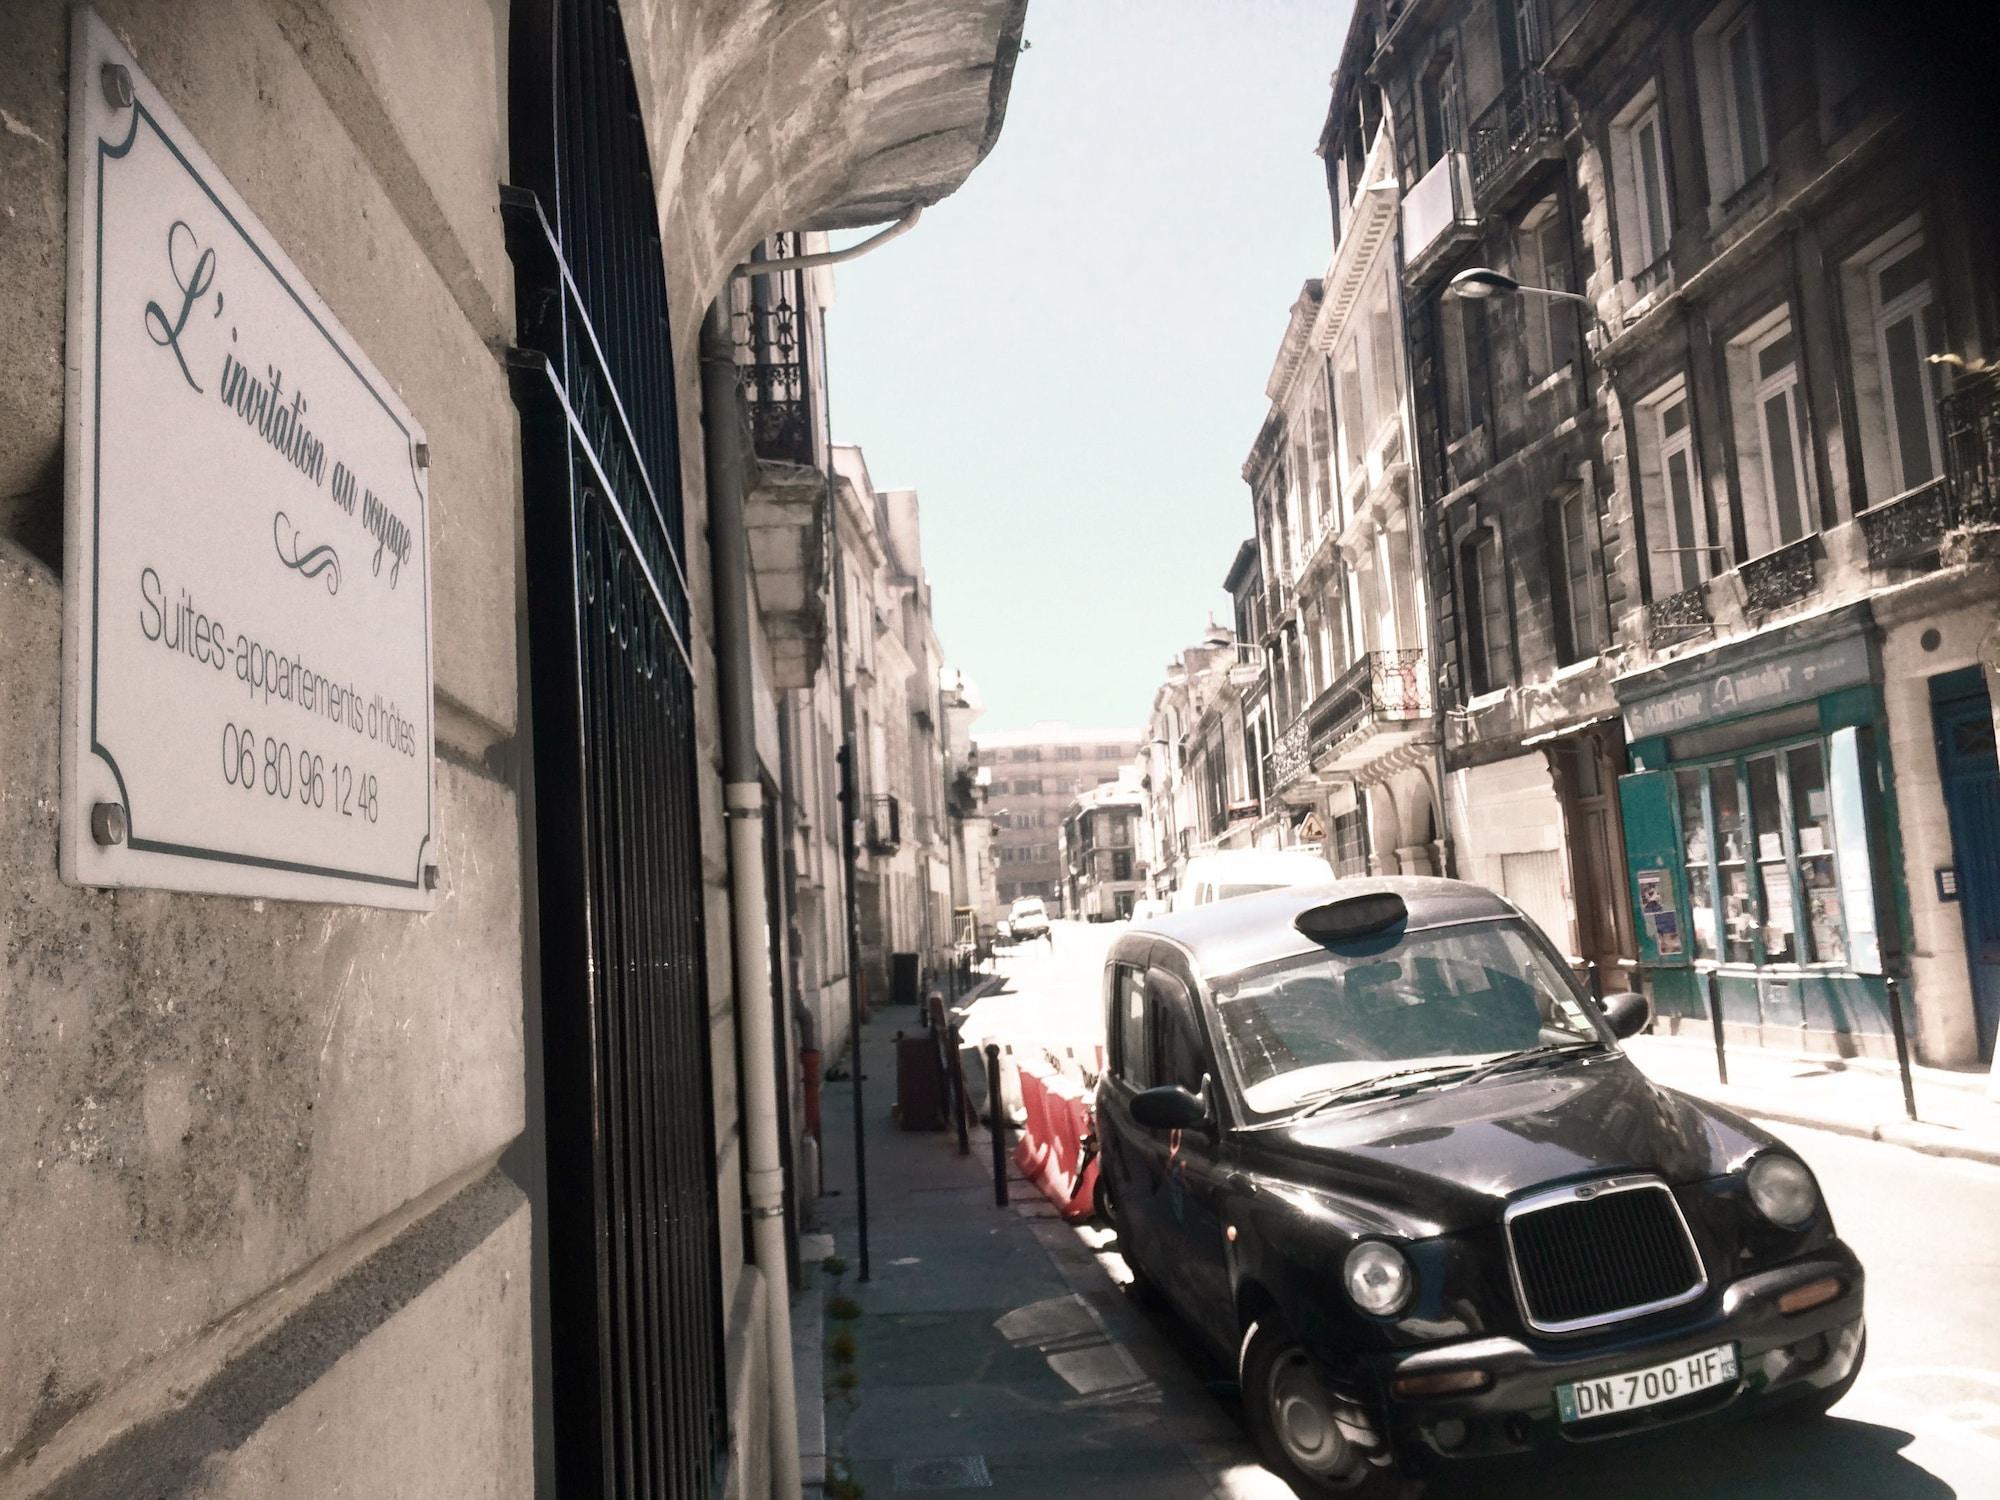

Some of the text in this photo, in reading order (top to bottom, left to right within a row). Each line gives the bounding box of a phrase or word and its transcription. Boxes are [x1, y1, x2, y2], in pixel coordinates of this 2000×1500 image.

[144, 220, 412, 590] L'invitation au voyage
[140, 567, 416, 757] Suites-appartements d'hôtes
[222, 722, 379, 823] 06 80 96 12 48
